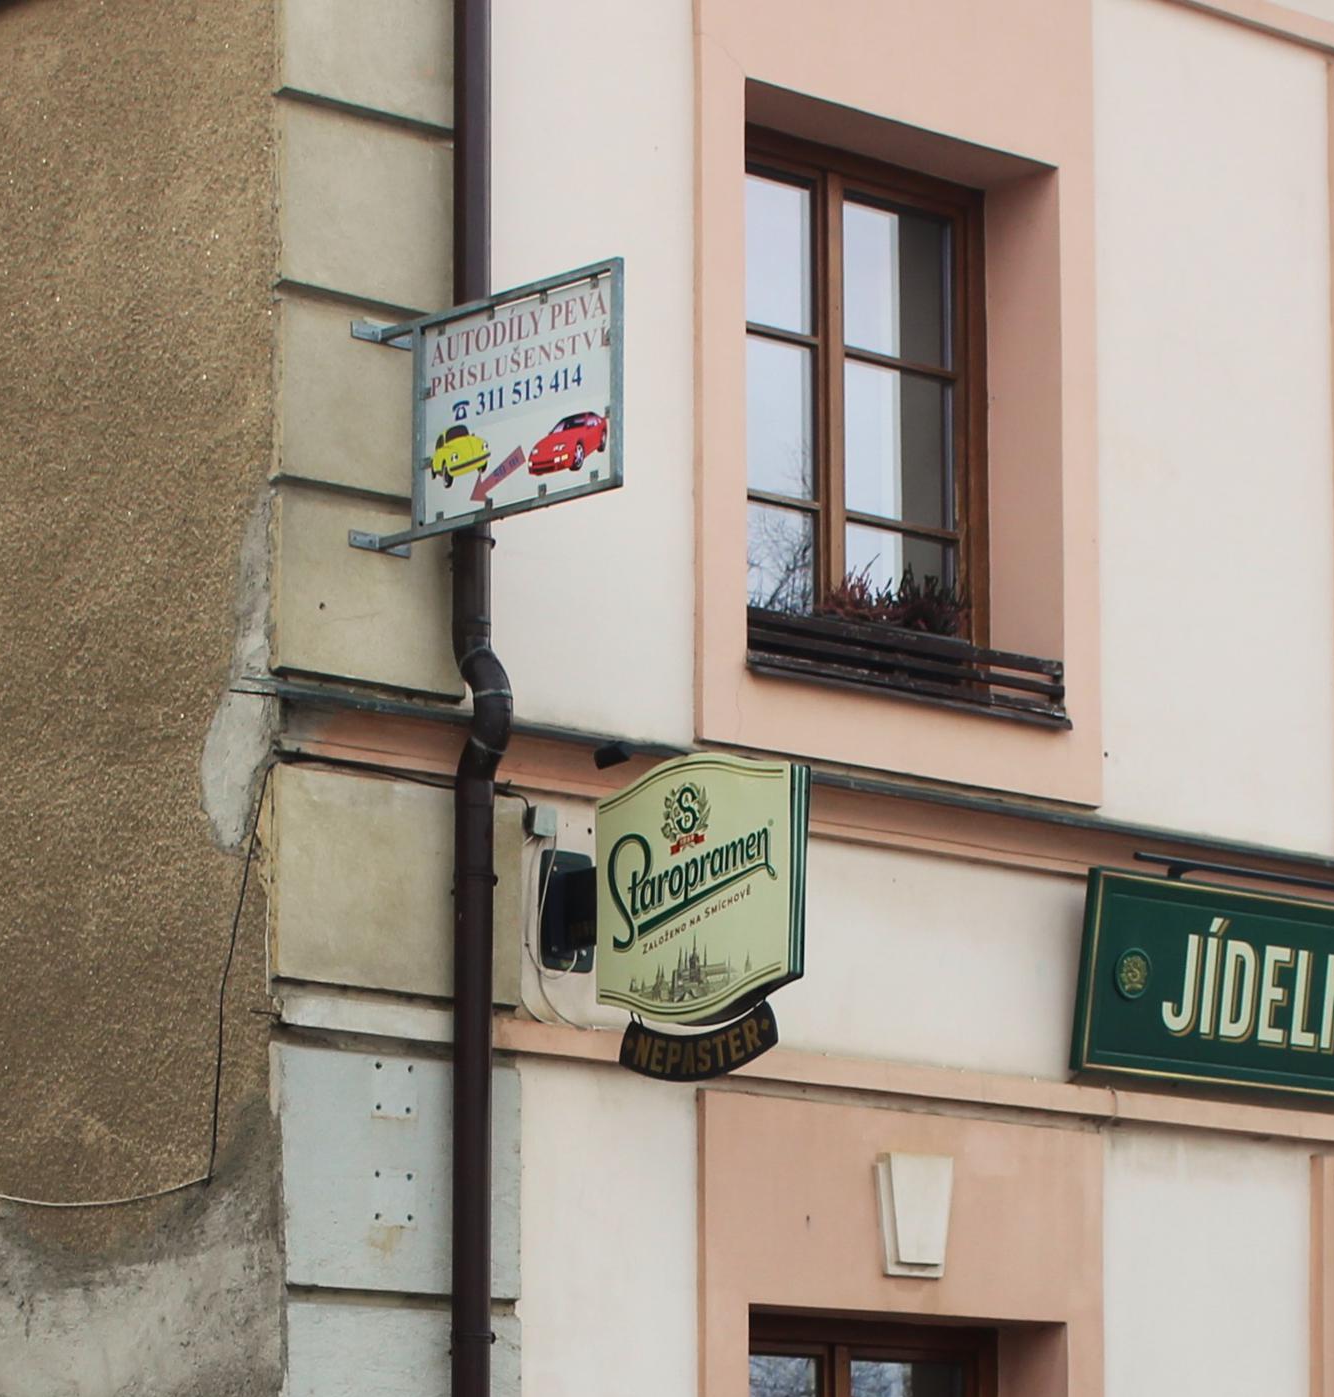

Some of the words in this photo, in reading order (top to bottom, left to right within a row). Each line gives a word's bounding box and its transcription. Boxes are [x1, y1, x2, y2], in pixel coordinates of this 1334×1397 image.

[431, 307, 544, 368] AUTODÍLY
[550, 290, 607, 331] PEVA
[431, 320, 610, 398] PŘÍSLUŠENSTVÍ
[476, 386, 504, 416] 311
[512, 374, 543, 405] 513
[550, 363, 582, 393] 414
[607, 826, 776, 951] Staropramen
[689, 914, 701, 928] NA
[634, 1018, 762, 1074] NEPASTER
